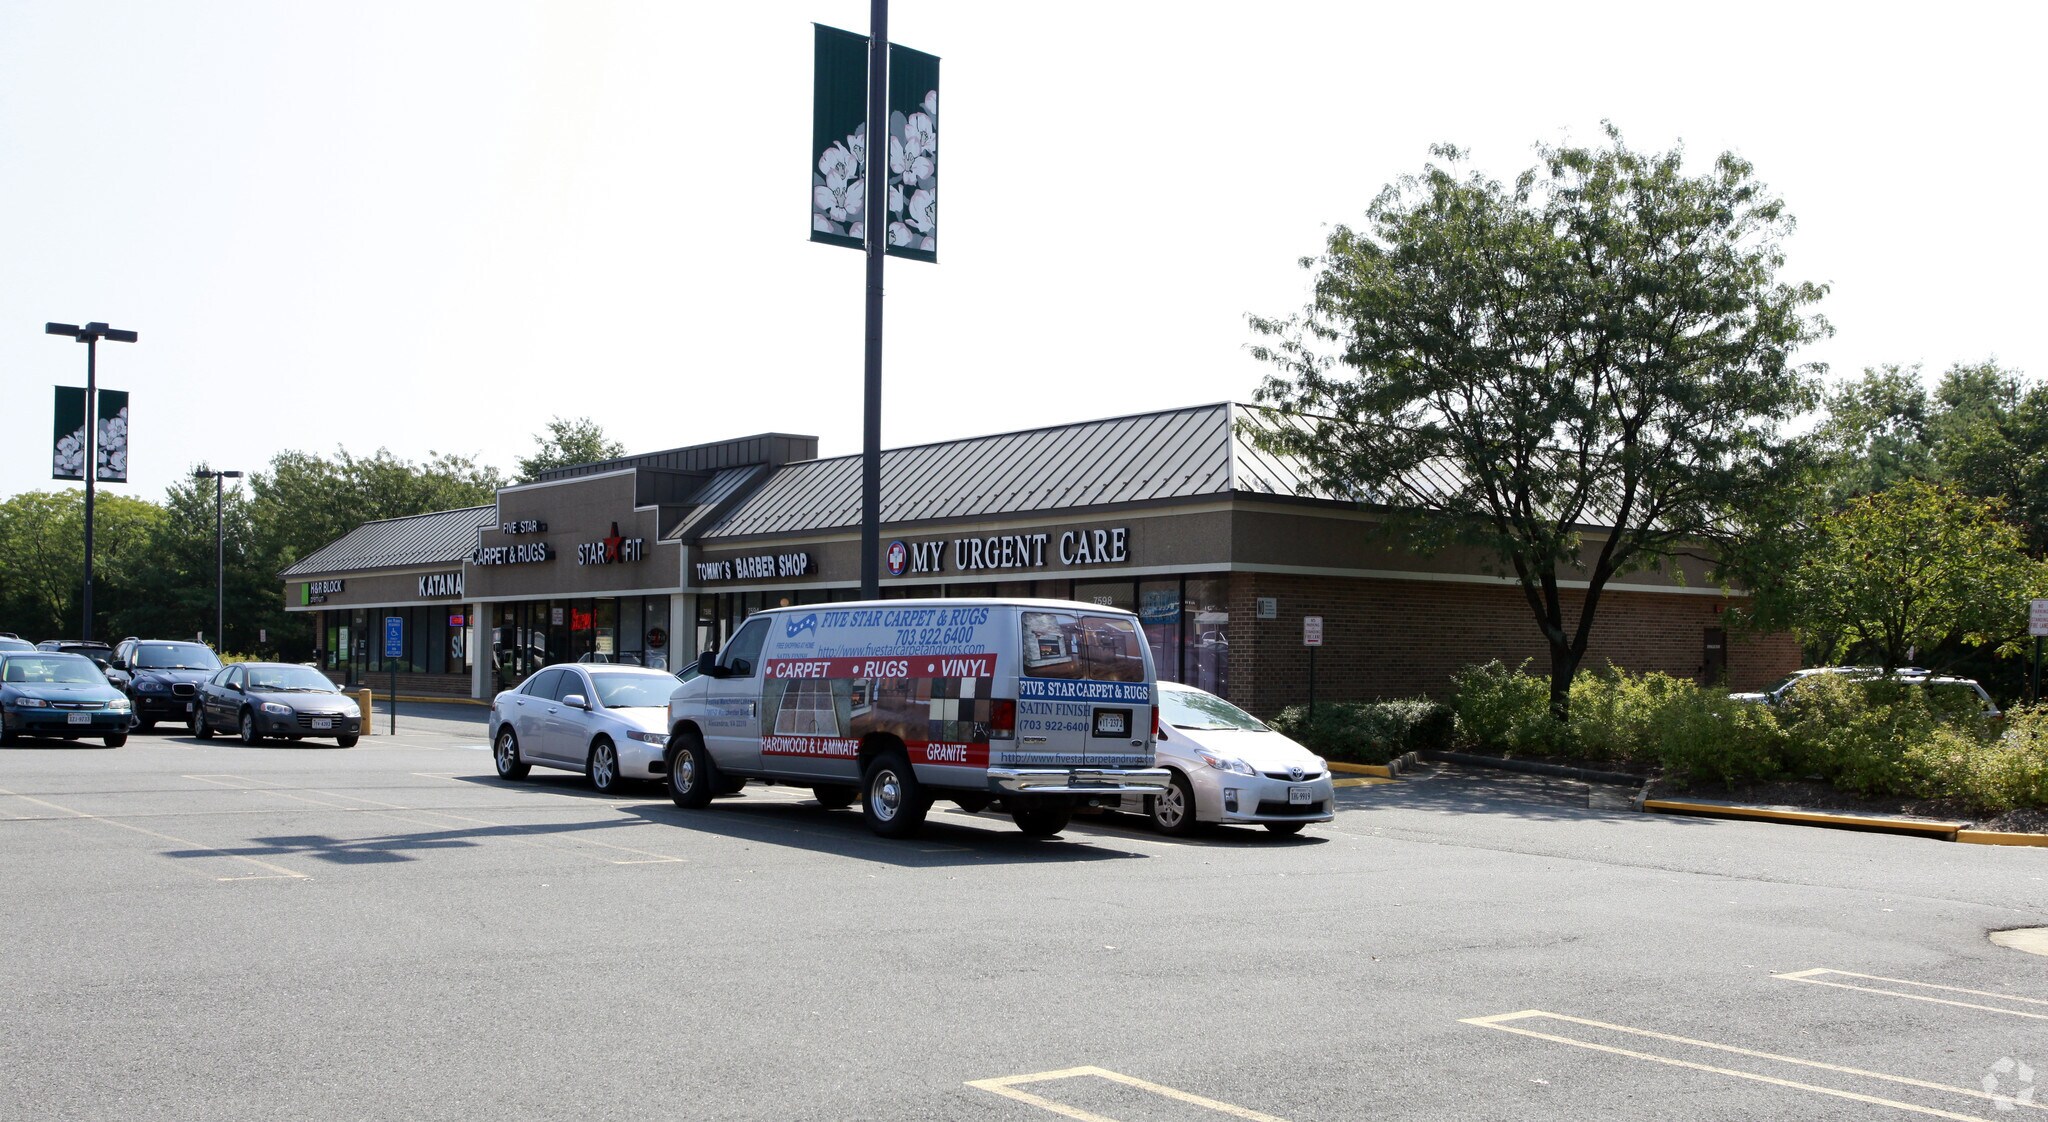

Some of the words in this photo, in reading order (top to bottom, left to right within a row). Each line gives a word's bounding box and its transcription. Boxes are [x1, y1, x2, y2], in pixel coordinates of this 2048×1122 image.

[503, 522, 517, 534] FIVE
[520, 520, 537, 533] STAR
[472, 546, 508, 566] CARPET
[509, 548, 516, 563] &
[518, 543, 546, 563] RUGS
[578, 542, 605, 566] STAR
[625, 538, 642, 561] FIT
[912, 541, 944, 572] MY
[954, 533, 1047, 570] URGENT
[1059, 528, 1127, 565] CARE
[696, 561, 732, 580] TOMMY'S
[735, 556, 776, 579] BARBER
[779, 552, 808, 577] SHOP
[310, 582, 322, 594] H&R
[323, 580, 342, 593] BLOCK
[418, 573, 463, 597] KATANA
[821, 612, 848, 628] FIVE
[850, 611, 882, 627] STAR
[884, 609, 935, 627] CARPET
[936, 609, 947, 626] &
[950, 608, 989, 625] RUGS
[895, 626, 974, 646] 703.922.6400
[817, 643, 985, 659] http://www.fivestarcarpetandrugs.com
[776, 662, 831, 678] CARPET
[863, 661, 908, 677] RUGS
[941, 659, 991, 677] VINYL
[1019, 681, 1045, 696] FIVE
[1048, 682, 1076, 697] STAR
[1076, 682, 1114, 698] CARPET
[1114, 685, 1123, 698] &
[1123, 685, 1149, 700] RUGS
[1020, 702, 1053, 716] SATIN
[1055, 704, 1091, 717] FINISH
[1019, 720, 1041, 732] (703
[1045, 720, 1090, 732] 922-6400
[761, 736, 807, 753] HARDWOOD
[808, 739, 815, 754] &
[817, 739, 859, 756] LAMINATE
[927, 743, 967, 762] GRANITE
